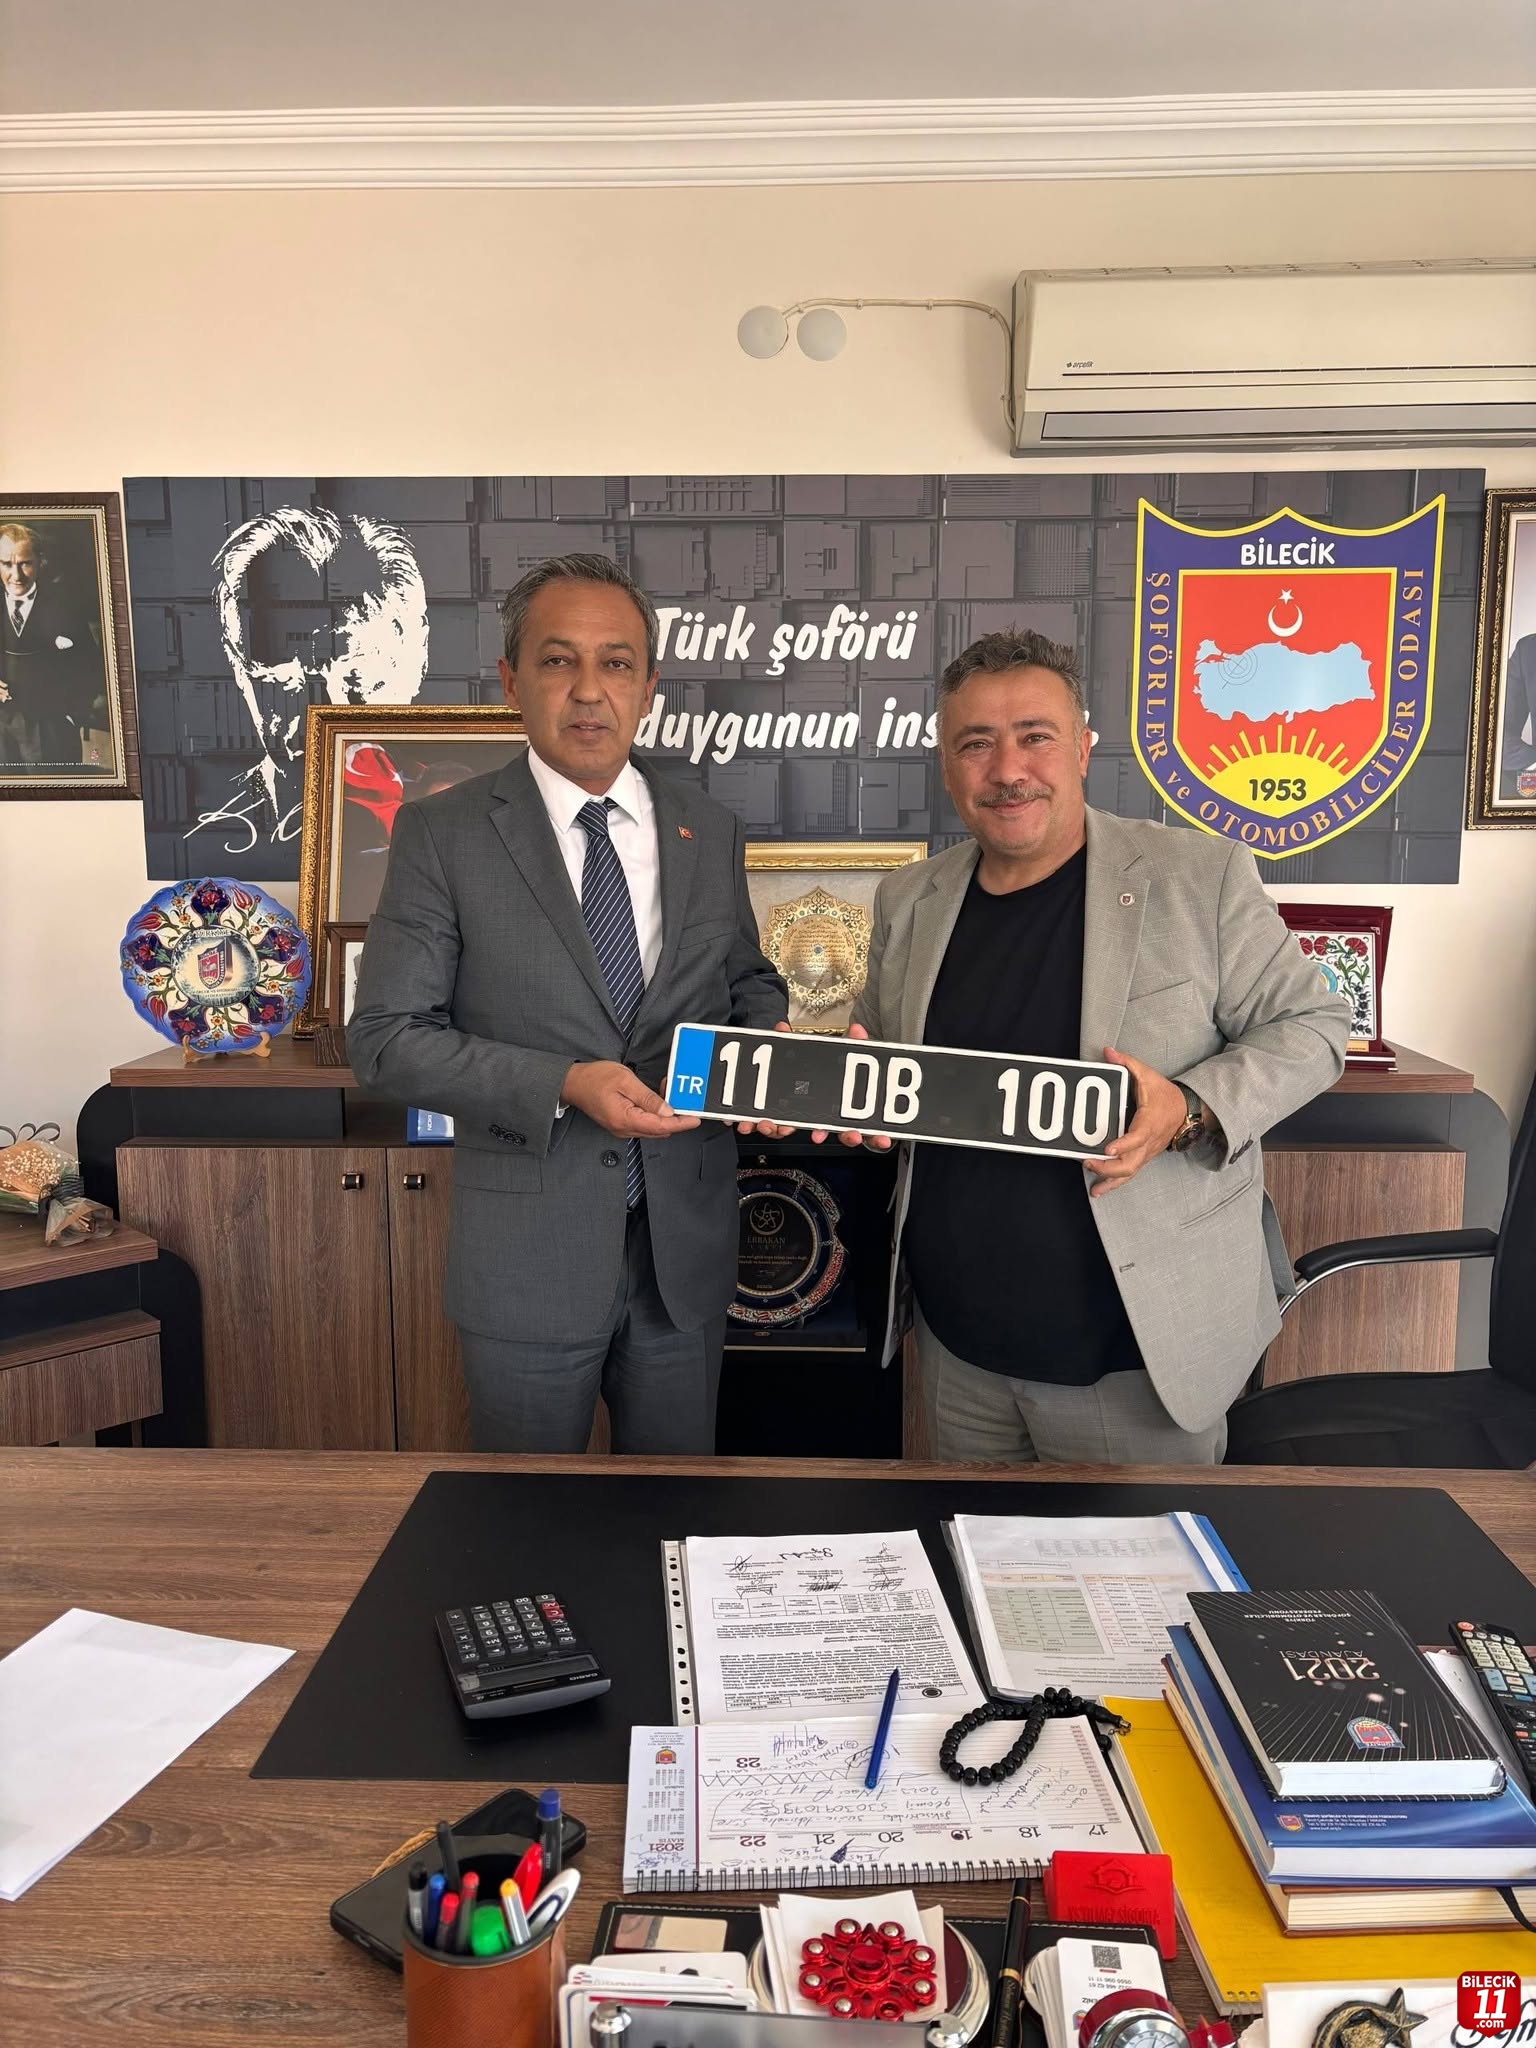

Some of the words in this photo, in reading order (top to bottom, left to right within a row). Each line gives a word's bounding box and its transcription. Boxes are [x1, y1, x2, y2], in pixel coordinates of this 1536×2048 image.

[1239, 536, 1336, 567] BİLECİK
[654, 604, 756, 662] Türk
[765, 603, 919, 677] şoförü
[1145, 572, 1174, 764] ŞOFÖRLER
[1166, 769, 1192, 801] ve
[1198, 698, 1417, 848] OTOMOBİLCİLER
[1397, 568, 1425, 682] ODASI
[632, 693, 860, 765] duygunun
[1248, 778, 1307, 803] 1953
[676, 1073, 704, 1096] TR
[718, 1040, 774, 1111] 11
[839, 1051, 923, 1125] DB
[996, 1067, 1112, 1148] 100
[1277, 1650, 1363, 1658] AJANDASI
[1282, 1657, 1381, 1681] 2021
[568, 1672, 599, 1681] CASIO
[736, 1757, 761, 1769] 23
[1018, 1826, 1042, 1839] 18
[1089, 1824, 1108, 1836] 17
[739, 1835, 767, 1848] 22
[812, 1833, 836, 1845] 21
[878, 1831, 904, 1844] 20
[648, 1842, 685, 1852] 2021
